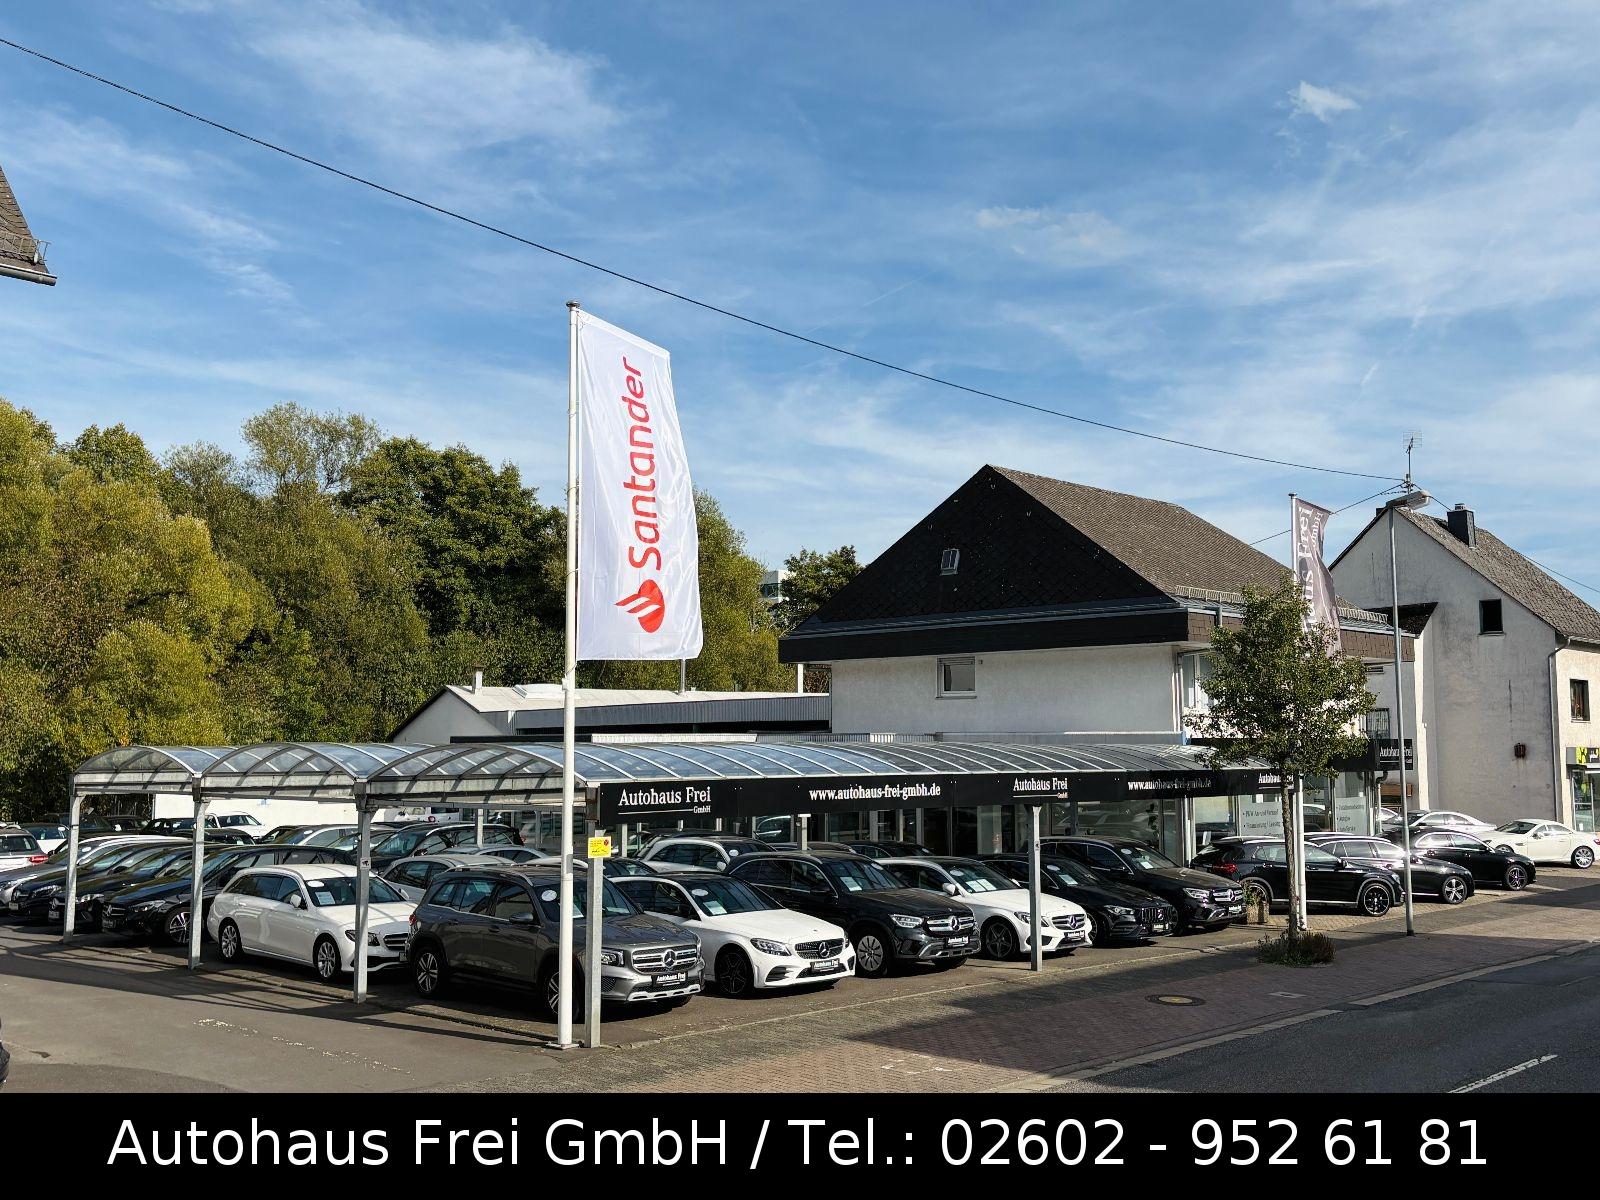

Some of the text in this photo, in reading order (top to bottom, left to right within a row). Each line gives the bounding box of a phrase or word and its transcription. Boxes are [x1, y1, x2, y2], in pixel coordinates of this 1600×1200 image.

[621, 355, 662, 571] Santander
[809, 782, 941, 801] www.autohaus-frei-gmbh.de
[1013, 777, 1068, 792] Autohaus Frei
[618, 786, 712, 806] Autohaus Frei
[693, 805, 711, 814] GmbH
